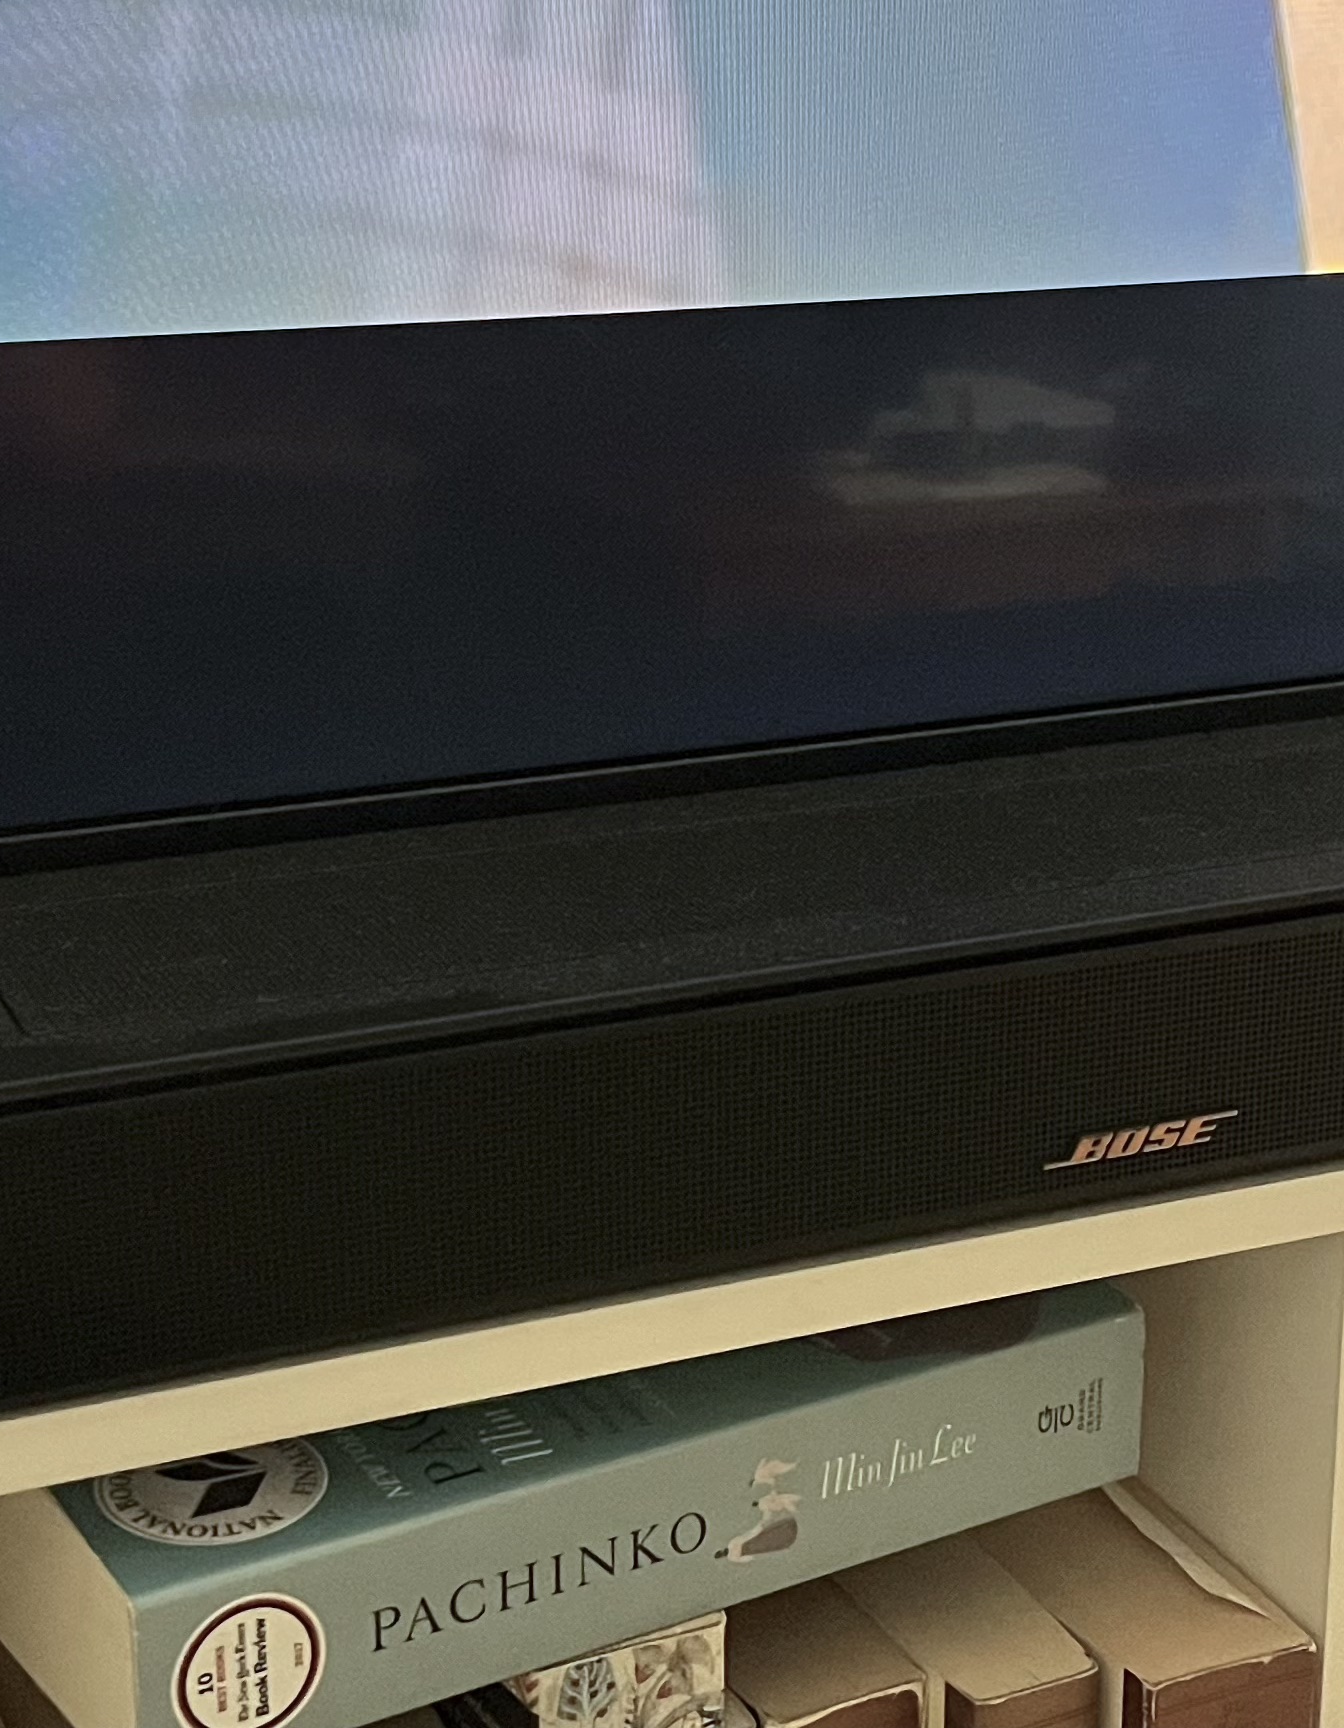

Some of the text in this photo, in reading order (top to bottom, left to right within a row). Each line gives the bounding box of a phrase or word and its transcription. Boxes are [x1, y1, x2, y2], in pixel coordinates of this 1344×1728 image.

[1043, 1109, 1239, 1171] BOSE
[821, 1423, 977, 1499] Min Jin Lee
[108, 1472, 285, 1539] NATIONAL BOO
[370, 1511, 707, 1652] PACHINKO
[197, 1672, 214, 1695] 10
[253, 1617, 270, 1718] Book Review
